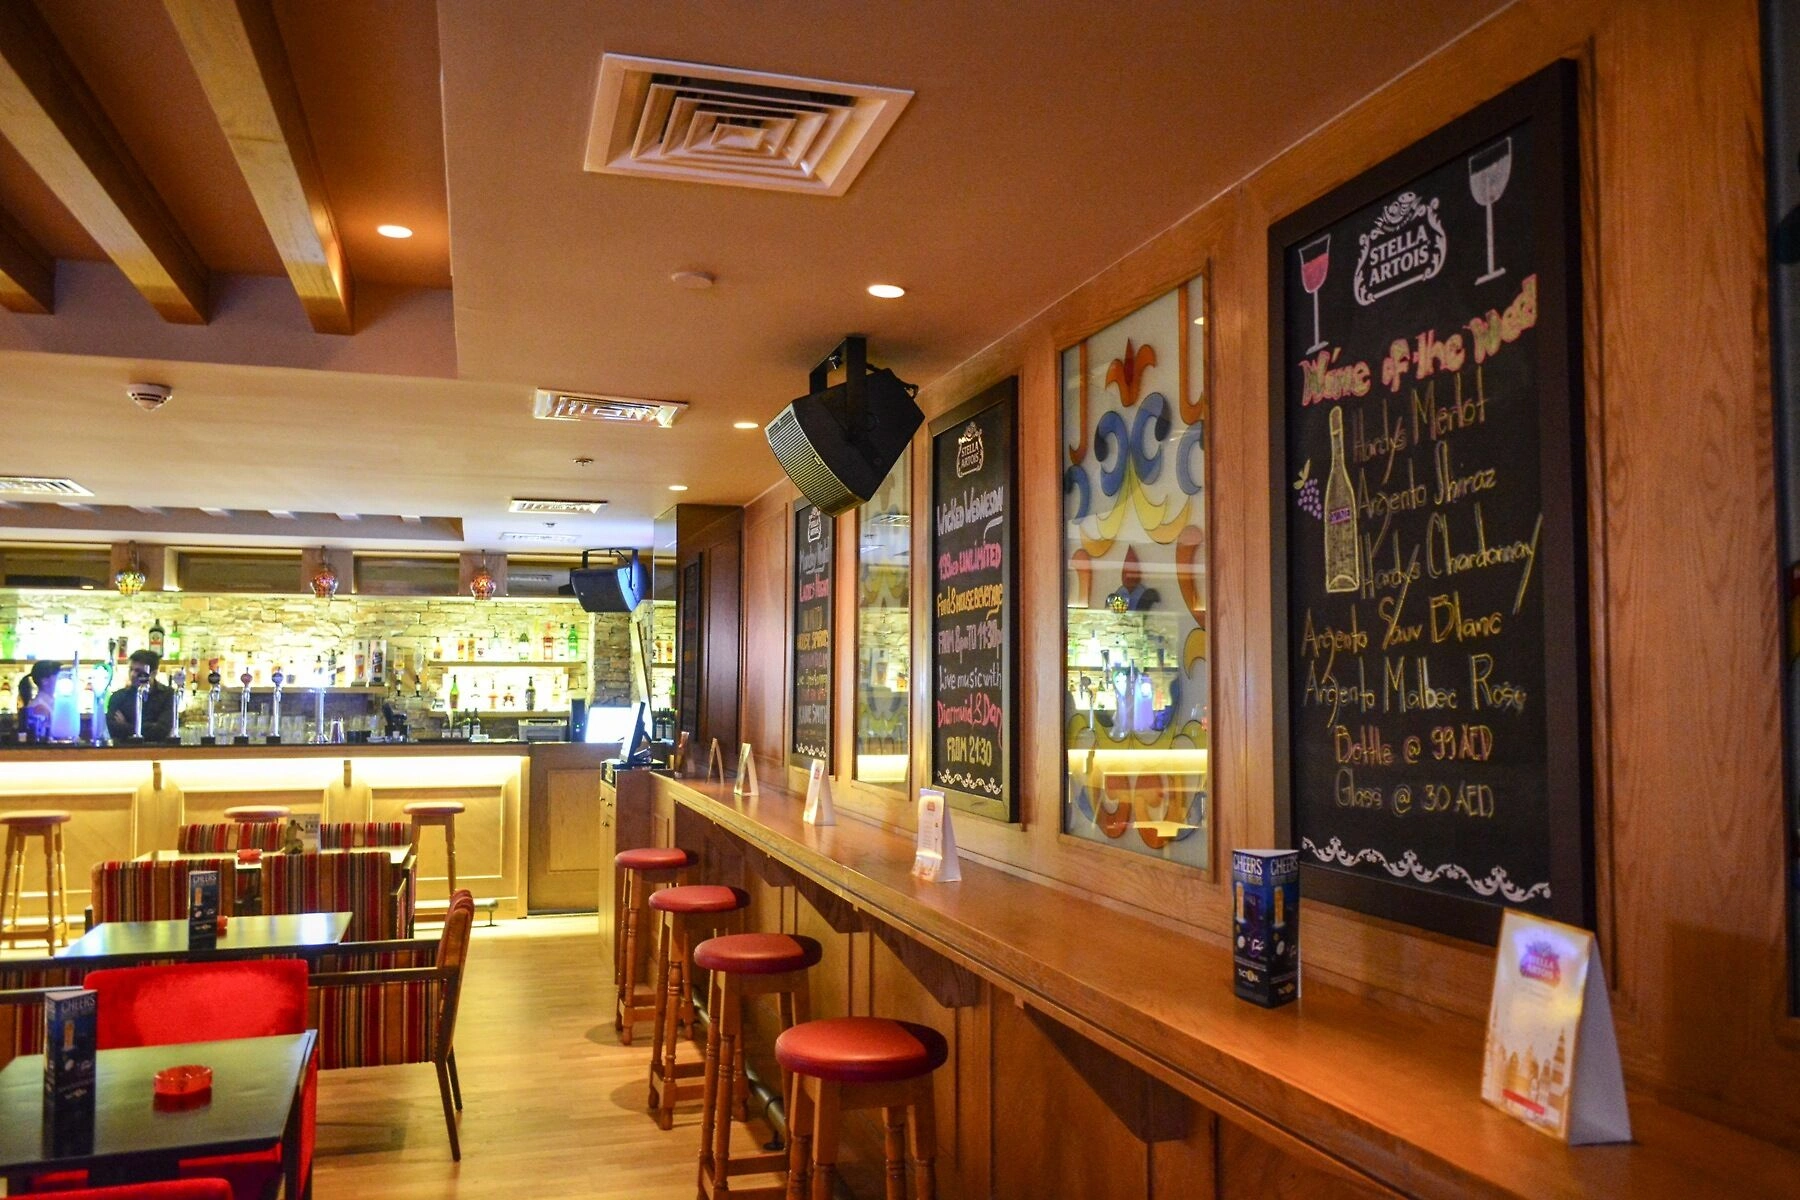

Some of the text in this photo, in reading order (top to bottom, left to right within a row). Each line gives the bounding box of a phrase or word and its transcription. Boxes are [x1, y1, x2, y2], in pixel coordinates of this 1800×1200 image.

[1369, 225, 1428, 266] STELLA
[1369, 244, 1429, 287] ARTOIS
[1413, 329, 1465, 380] the
[1411, 366, 1488, 445] Merlot
[961, 441, 979, 457] STELLA
[957, 667, 983, 688] music
[982, 662, 1002, 690] with
[1403, 736, 1421, 764] @
[1392, 784, 1413, 818] @
[1234, 853, 1263, 876] CHEERS
